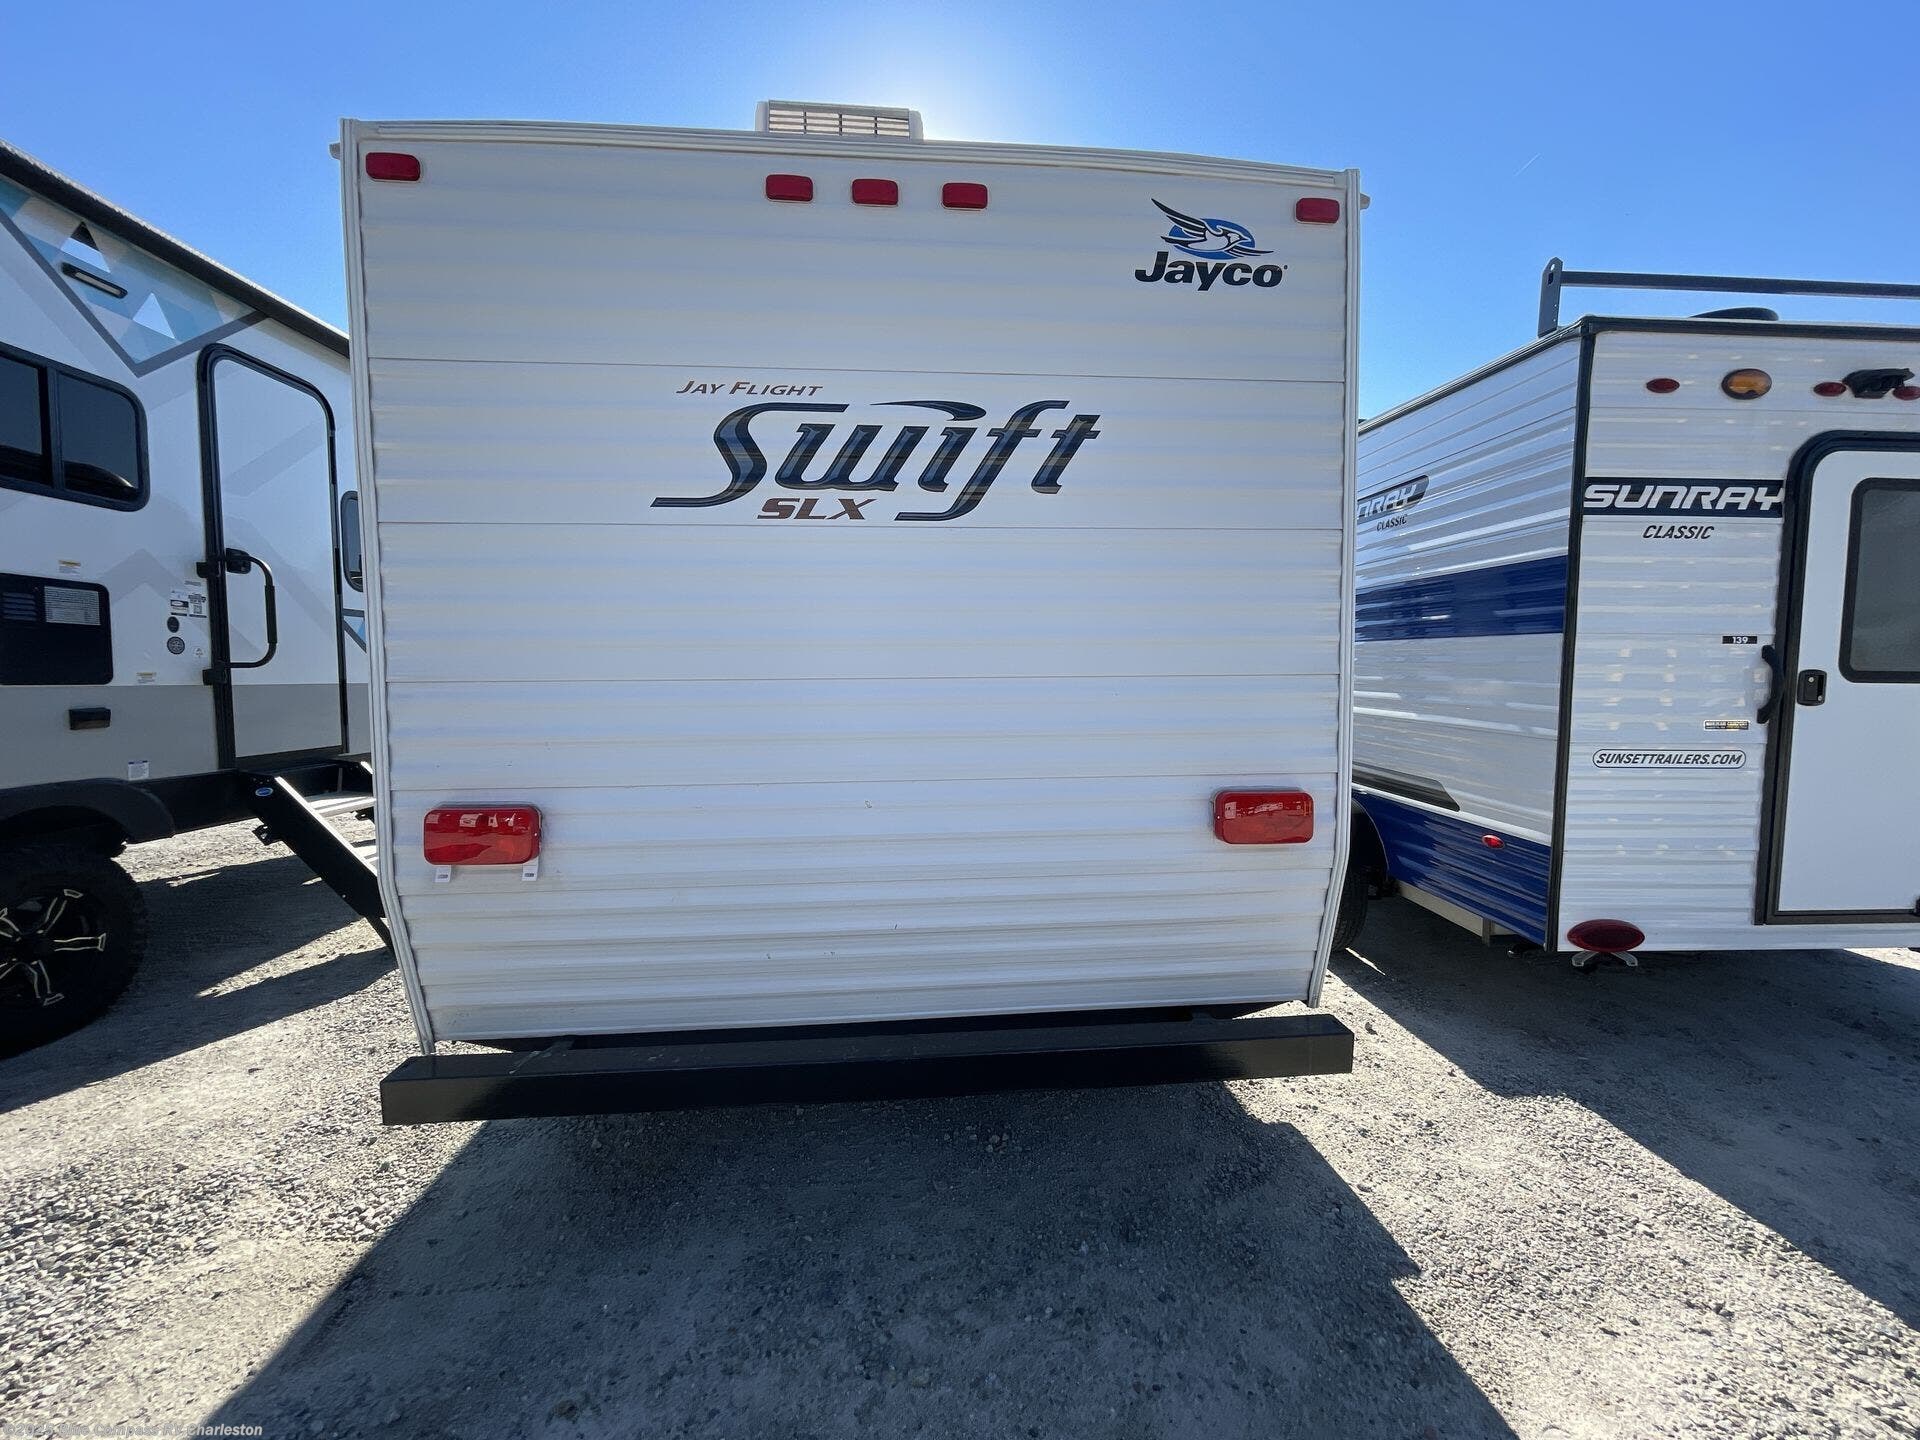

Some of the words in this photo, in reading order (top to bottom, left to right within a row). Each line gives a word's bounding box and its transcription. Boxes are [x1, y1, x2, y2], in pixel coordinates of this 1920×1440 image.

[1134, 250, 1284, 291] Jayco
[675, 380, 723, 395] JAY
[728, 381, 824, 397] FLIGHT
[650, 399, 1102, 521] Swift
[1356, 484, 1417, 519] NRAY
[1583, 483, 1784, 512] SUNRAY
[757, 497, 878, 520] SLX
[1376, 514, 1408, 531] CLASSIC
[1642, 524, 1715, 540] CLASSIC
[1732, 636, 1749, 645] 139
[1596, 752, 1742, 766] SUNSETTRAILERS.COM
